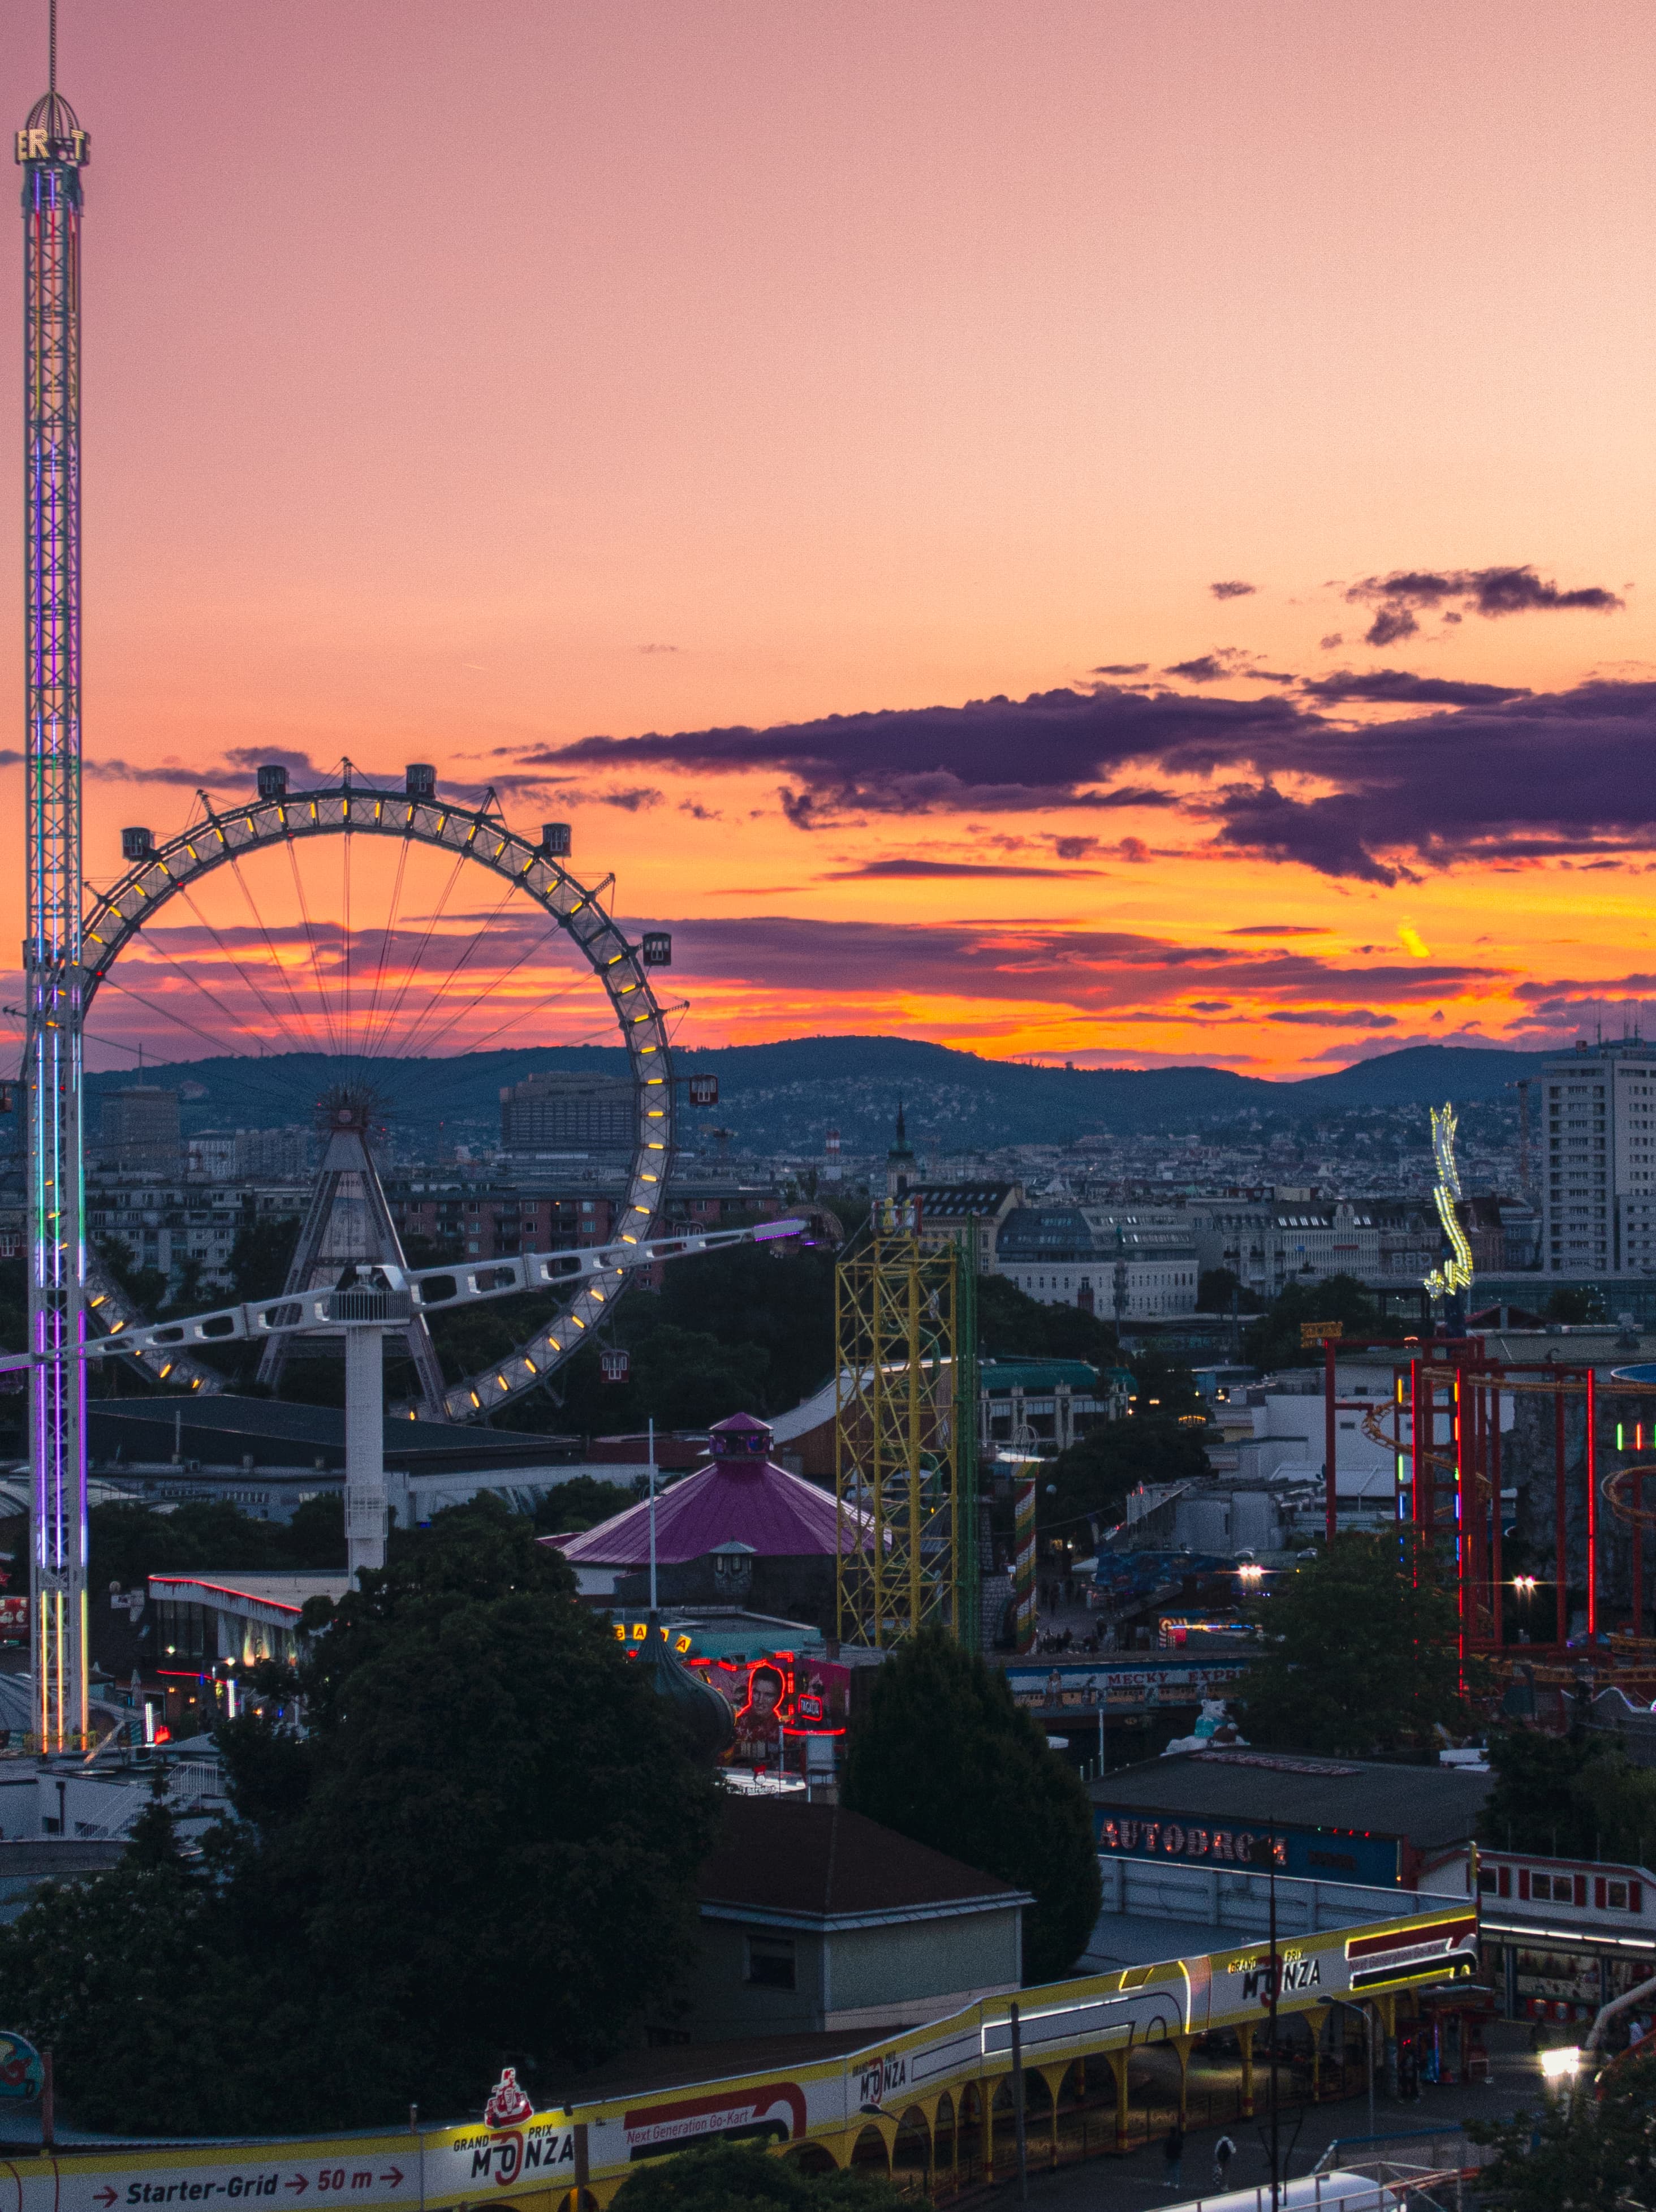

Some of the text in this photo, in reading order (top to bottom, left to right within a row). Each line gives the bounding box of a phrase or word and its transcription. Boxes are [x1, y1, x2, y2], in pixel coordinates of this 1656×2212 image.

[18, 128, 50, 161] ER
[1107, 1672, 1168, 1685] MECKY
[860, 2059, 905, 2103] MONZA
[453, 2124, 553, 2151] GRAND PRIX
[627, 2110, 748, 2144] Next Generation Go-Kart
[471, 2132, 573, 2182] MONZA
[126, 2169, 372, 2205] Starter-Grid 50 m
